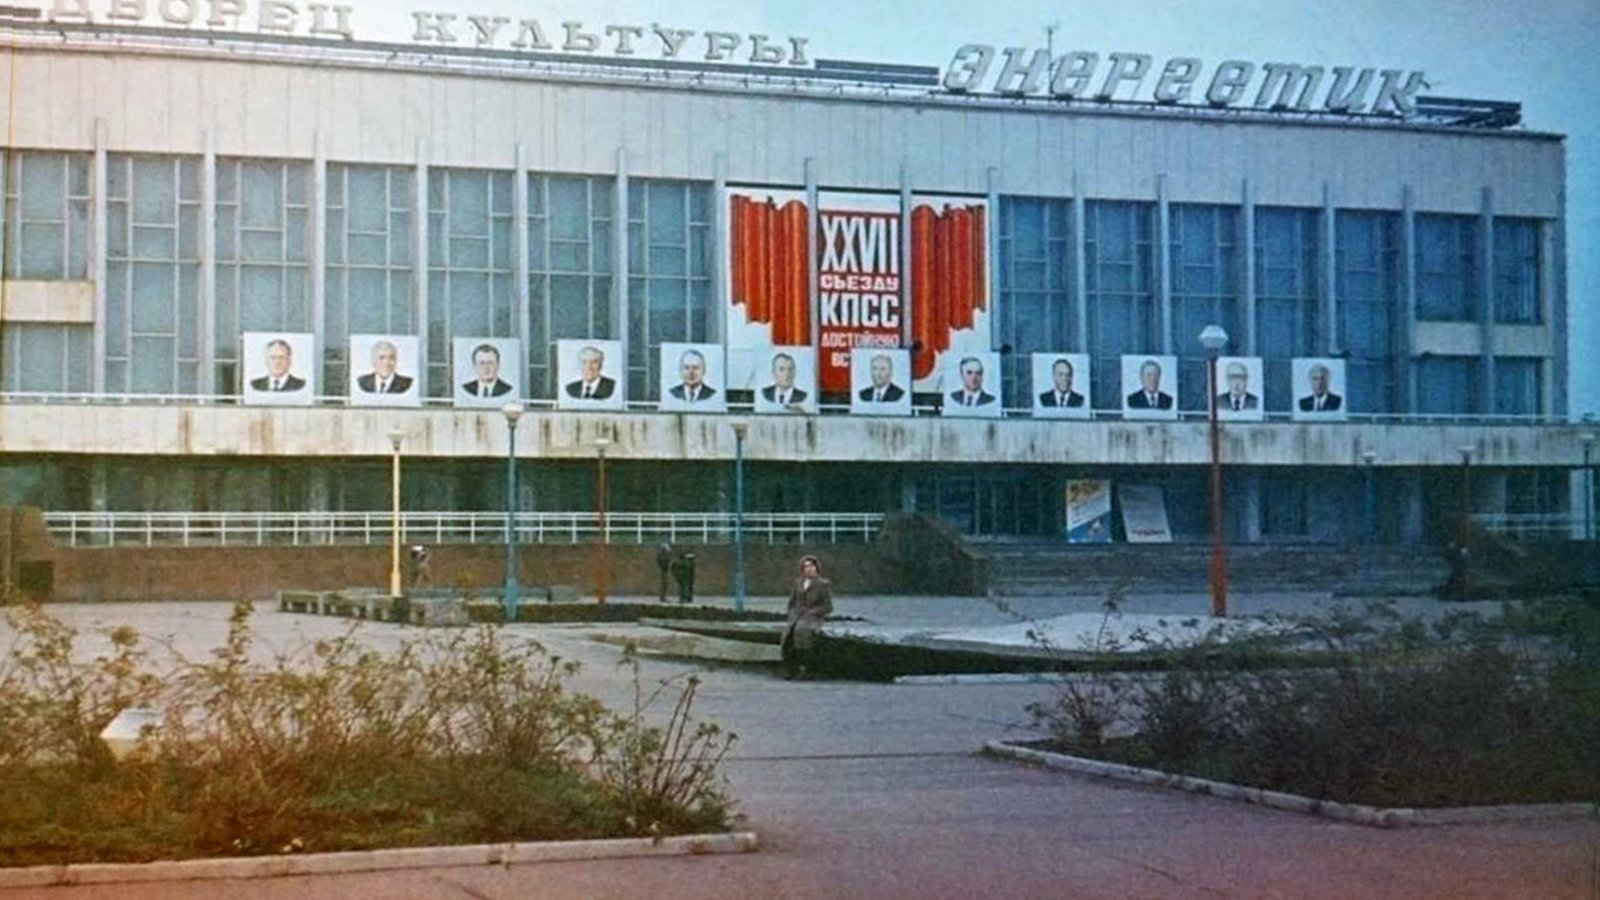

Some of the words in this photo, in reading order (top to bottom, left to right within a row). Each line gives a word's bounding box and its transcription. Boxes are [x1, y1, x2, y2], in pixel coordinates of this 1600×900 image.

[411, 12, 810, 66] КУЛЬТУРЫ
[820, 214, 898, 274] XXVII
[821, 293, 899, 328] КПСС
